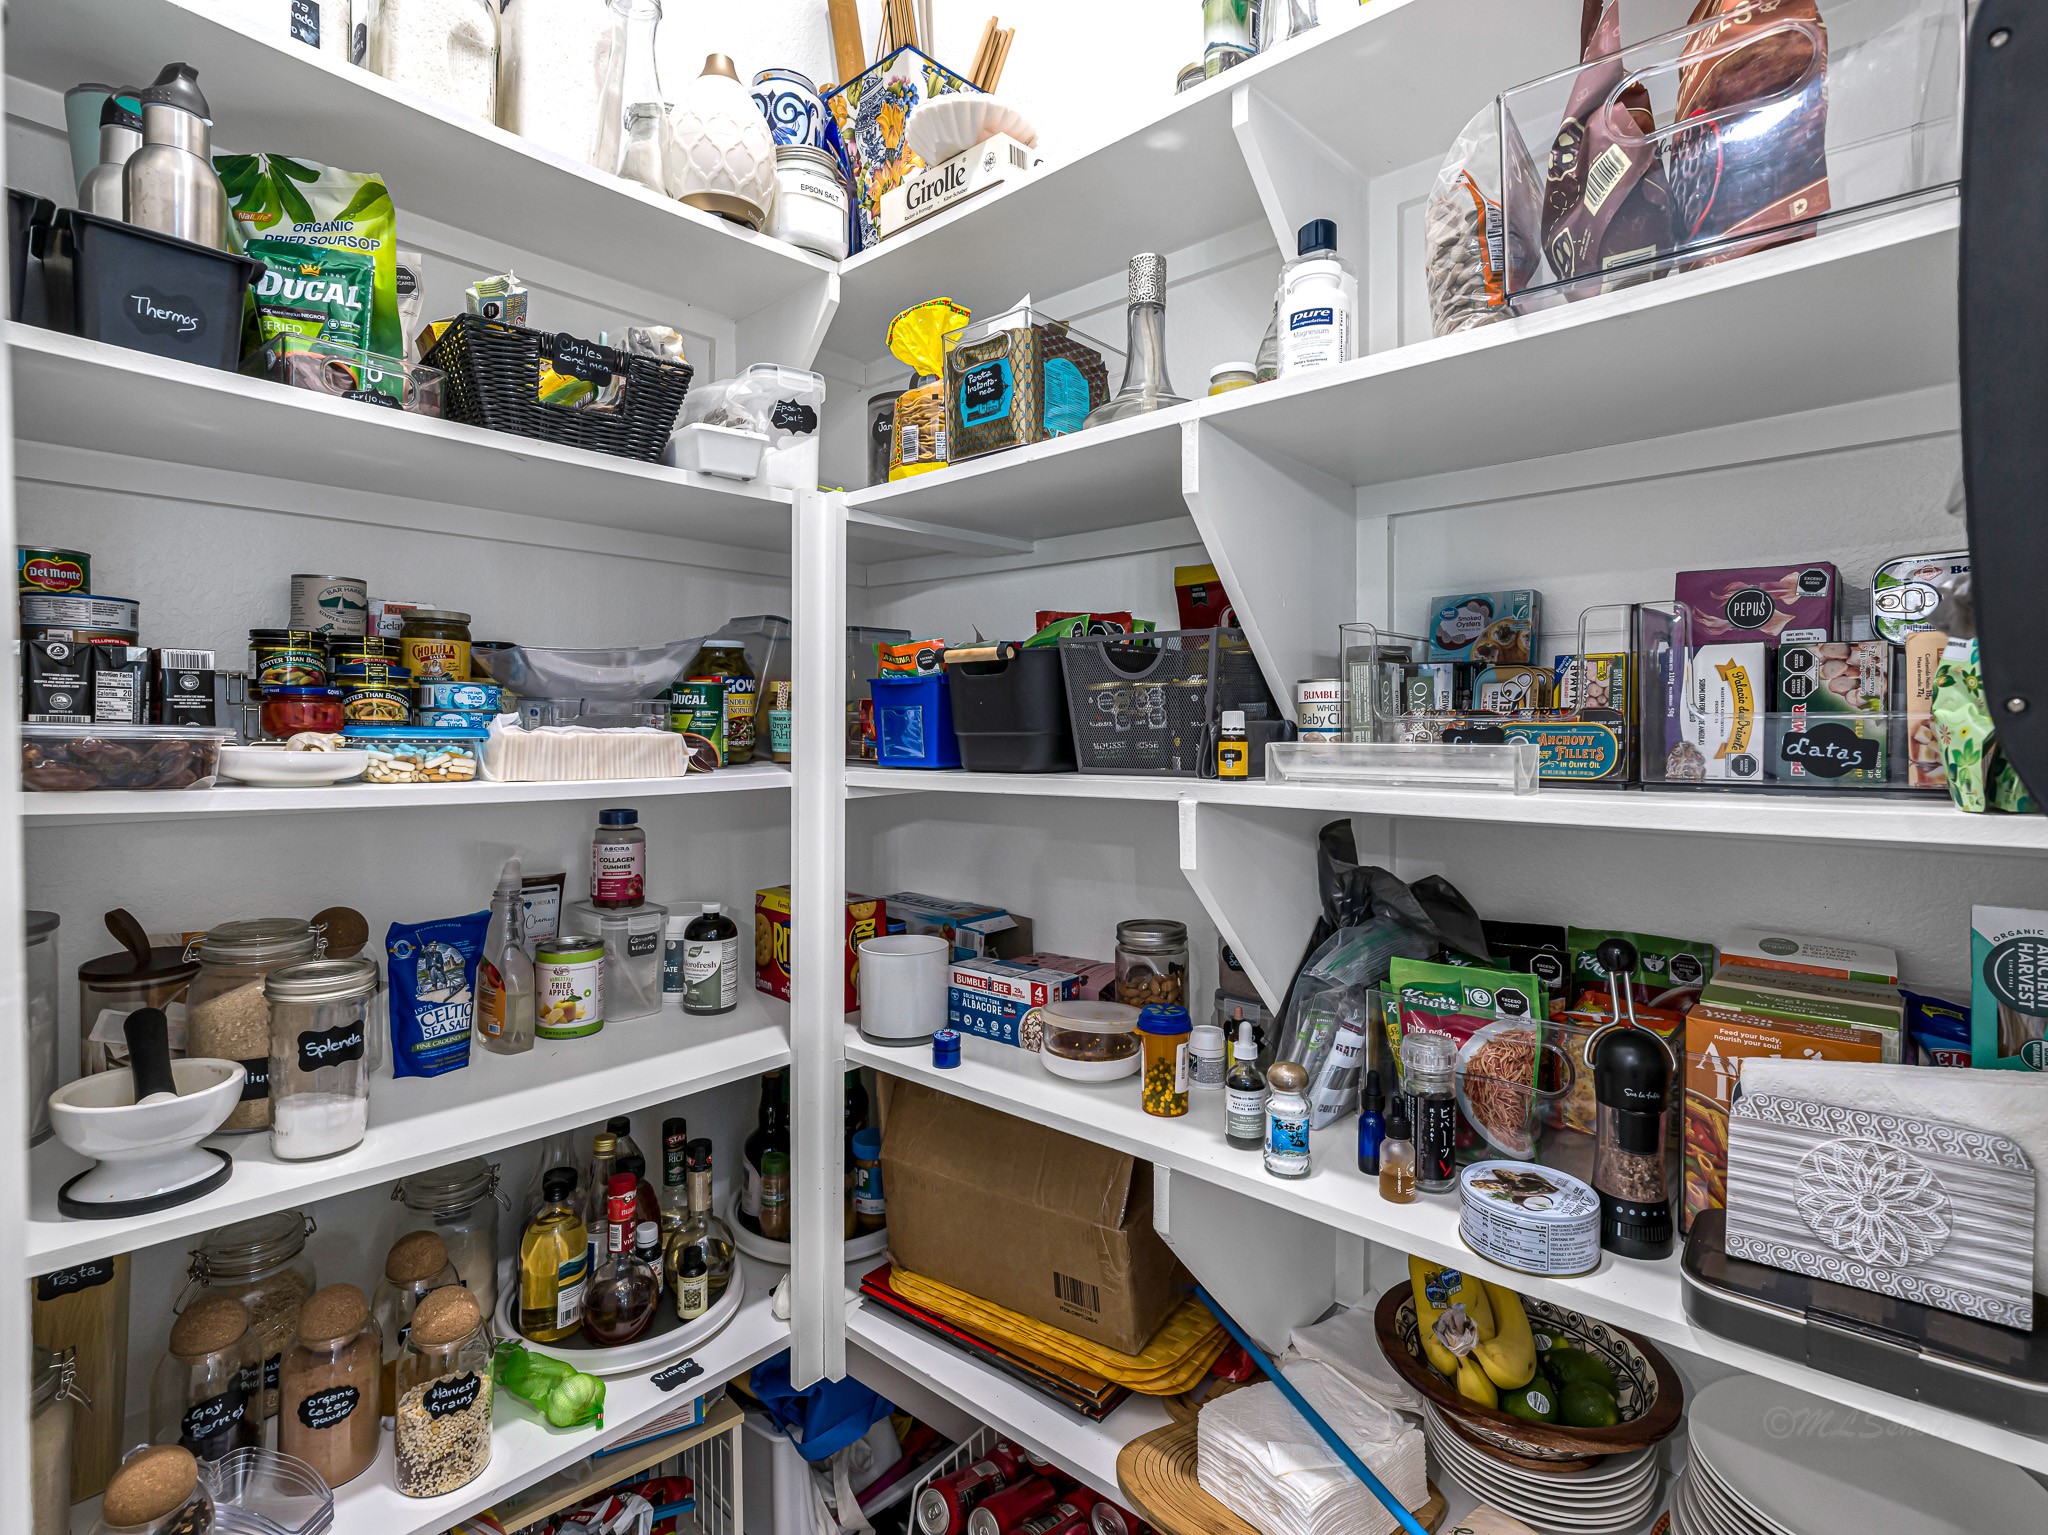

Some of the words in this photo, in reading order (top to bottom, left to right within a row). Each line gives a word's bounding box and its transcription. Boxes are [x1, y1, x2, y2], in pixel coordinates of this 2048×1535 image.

[800, 184, 824, 199] EPSON
[824, 190, 841, 203] SALT
[906, 163, 967, 211] Girolle
[291, 220, 355, 233] ORGANIC
[307, 235, 382, 255] SOURSOP
[274, 264, 298, 273] SINCE
[256, 270, 364, 310] DUCAL
[130, 294, 199, 333] Thermos
[1292, 309, 1331, 325] pure
[559, 338, 603, 361] Chiles
[29, 566, 48, 579] Del
[49, 568, 81, 581] Monte
[325, 588, 343, 596] BAR
[1733, 600, 1767, 618] PEPUS
[376, 621, 403, 633] Gelat
[1456, 621, 1482, 630] Oysters
[412, 644, 456, 662] CHOLULA
[259, 657, 284, 670] BETTER
[285, 656, 305, 665] THAN
[97, 671, 118, 680] Nutrition
[119, 672, 133, 680] Facts
[96, 690, 118, 699] Calories
[122, 689, 133, 699] 20
[1569, 664, 1578, 709] ALAMAR
[1731, 671, 1748, 706] Palacio
[344, 692, 364, 704] ETTER
[467, 693, 483, 701] Tuna
[671, 691, 708, 706] DUCAL
[1303, 690, 1340, 701] BUMBLE
[1316, 704, 1340, 712] WHOL
[469, 714, 482, 722] MSC
[1302, 713, 1326, 728] Baby
[1537, 732, 1595, 747] ANCHOVY
[1731, 717, 1750, 751] Oriente
[1554, 745, 1605, 762] FILLETS
[1568, 761, 1588, 769] OLIVE
[1589, 761, 1601, 769] OIL
[598, 855, 636, 866] COLLAGEN
[602, 864, 632, 873] GUMMIES
[1993, 928, 2045, 943] ORGANIC
[1536, 962, 1556, 970] EXCESO
[2017, 942, 2035, 1010] HARVEST
[550, 981, 572, 990] FRIED
[955, 972, 987, 991] BUMBLE
[992, 980, 1010, 996] BEE
[548, 988, 575, 998] APPLES
[962, 991, 975, 1000] SOLID
[976, 994, 989, 1003] WHITE
[990, 997, 1000, 1006] TUNA
[1034, 986, 1043, 998] 4
[961, 997, 1003, 1016] ALBACORE
[1400, 987, 1460, 1013] Knorr
[1500, 996, 1522, 1005] EXCESO
[414, 1003, 434, 1015] 1976
[419, 1002, 472, 1028] CELTIC
[423, 1022, 448, 1040] SEA
[448, 1016, 471, 1032] SALT
[305, 1032, 362, 1058] Splenda
[415, 1040, 432, 1050] FINE
[432, 1033, 462, 1047] GROUND
[1713, 1036, 1742, 1047] nourish
[1745, 1040, 1763, 1049] your
[1719, 1028, 1739, 1040] Feed
[1742, 1033, 1759, 1044] your
[1761, 1036, 1783, 1048] body,
[1935, 1052, 1965, 1067] EL
[1288, 1131, 1307, 1148] 塩
[47, 1265, 103, 1287] Pasta
[431, 1377, 478, 1400] Harvest
[191, 1398, 224, 1420] Goji
